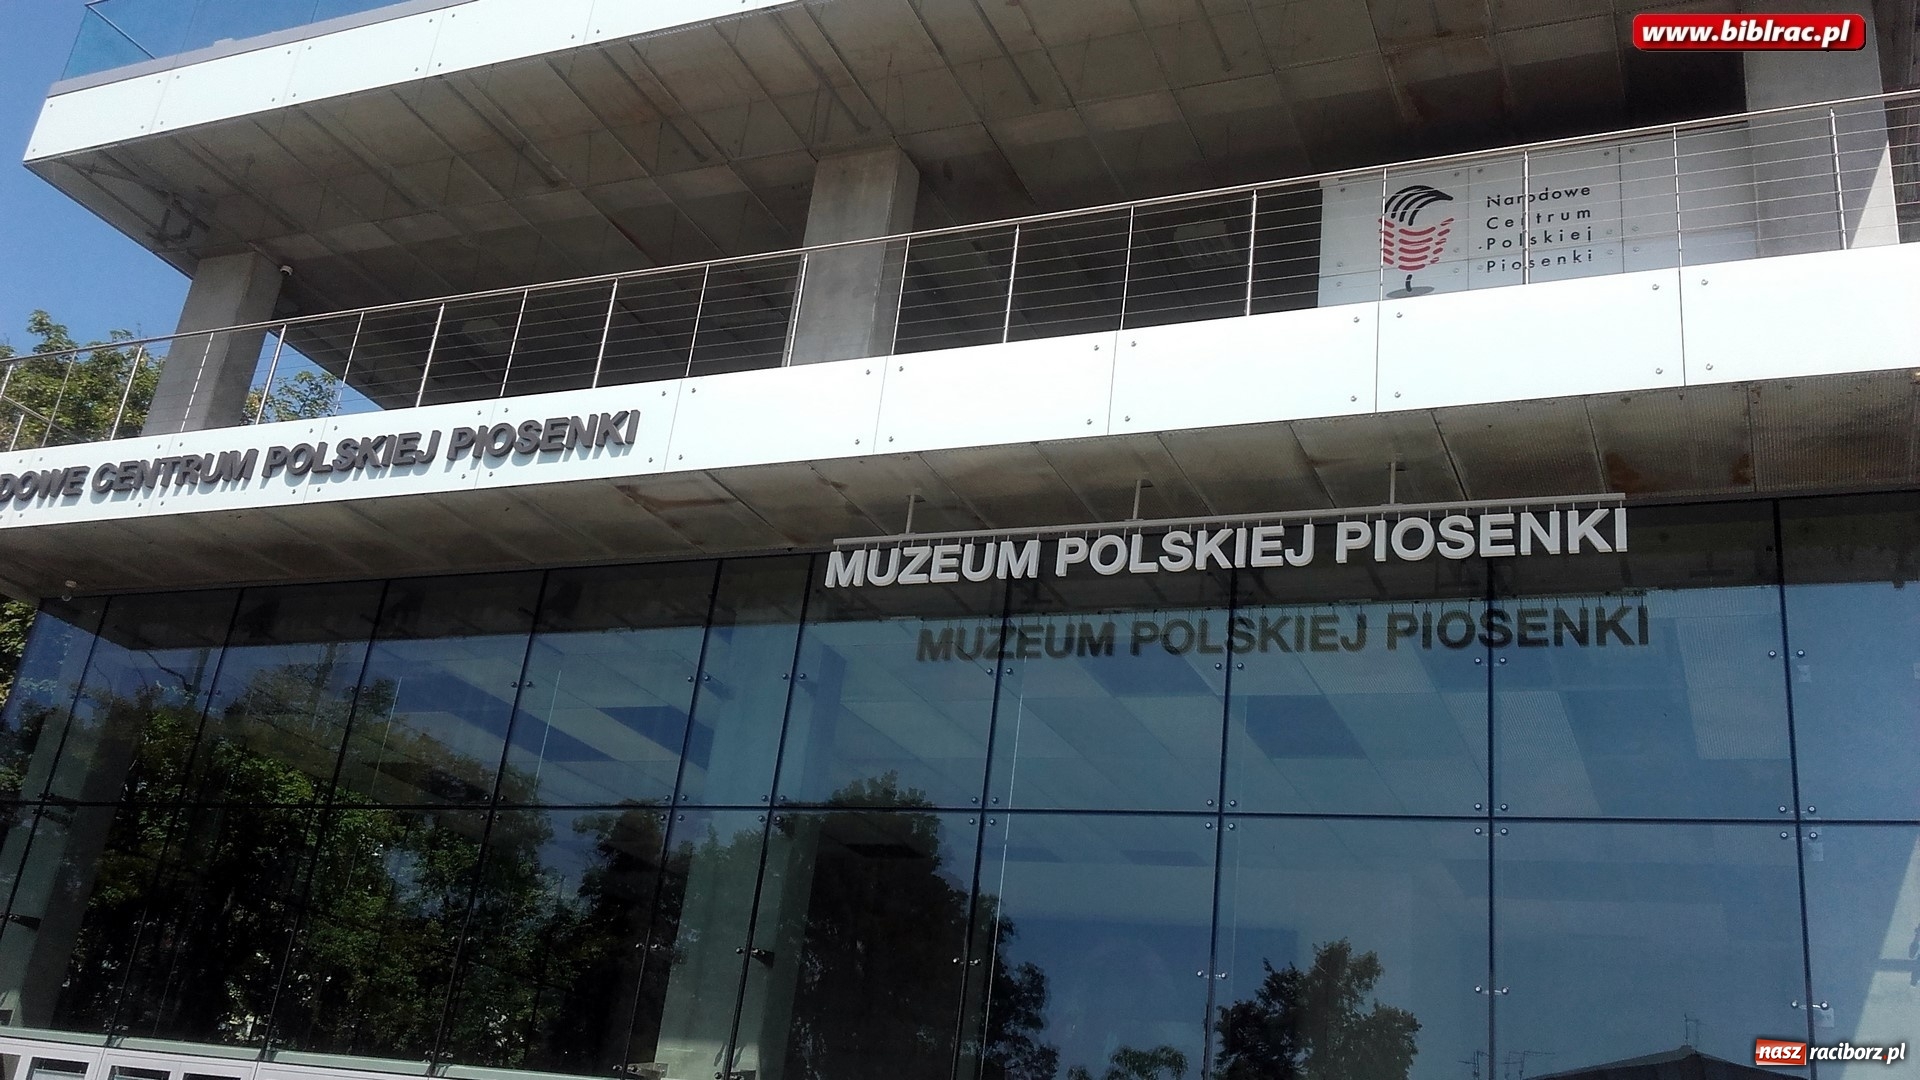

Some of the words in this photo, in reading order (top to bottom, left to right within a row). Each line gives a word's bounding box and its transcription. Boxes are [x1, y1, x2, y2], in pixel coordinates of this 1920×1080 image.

[1487, 187, 1590, 208] Narodowe
[1486, 226, 1592, 251] Polskiej
[1486, 249, 1592, 273] Piosenki
[91, 448, 259, 494] CENTRUM
[261, 430, 442, 478] POLSKIEJ
[447, 409, 641, 461] PIOSENKI
[824, 538, 1041, 588] MUZEUM
[1055, 523, 1315, 577] POLSKIEJ
[1335, 507, 1628, 564] PIOSENKI
